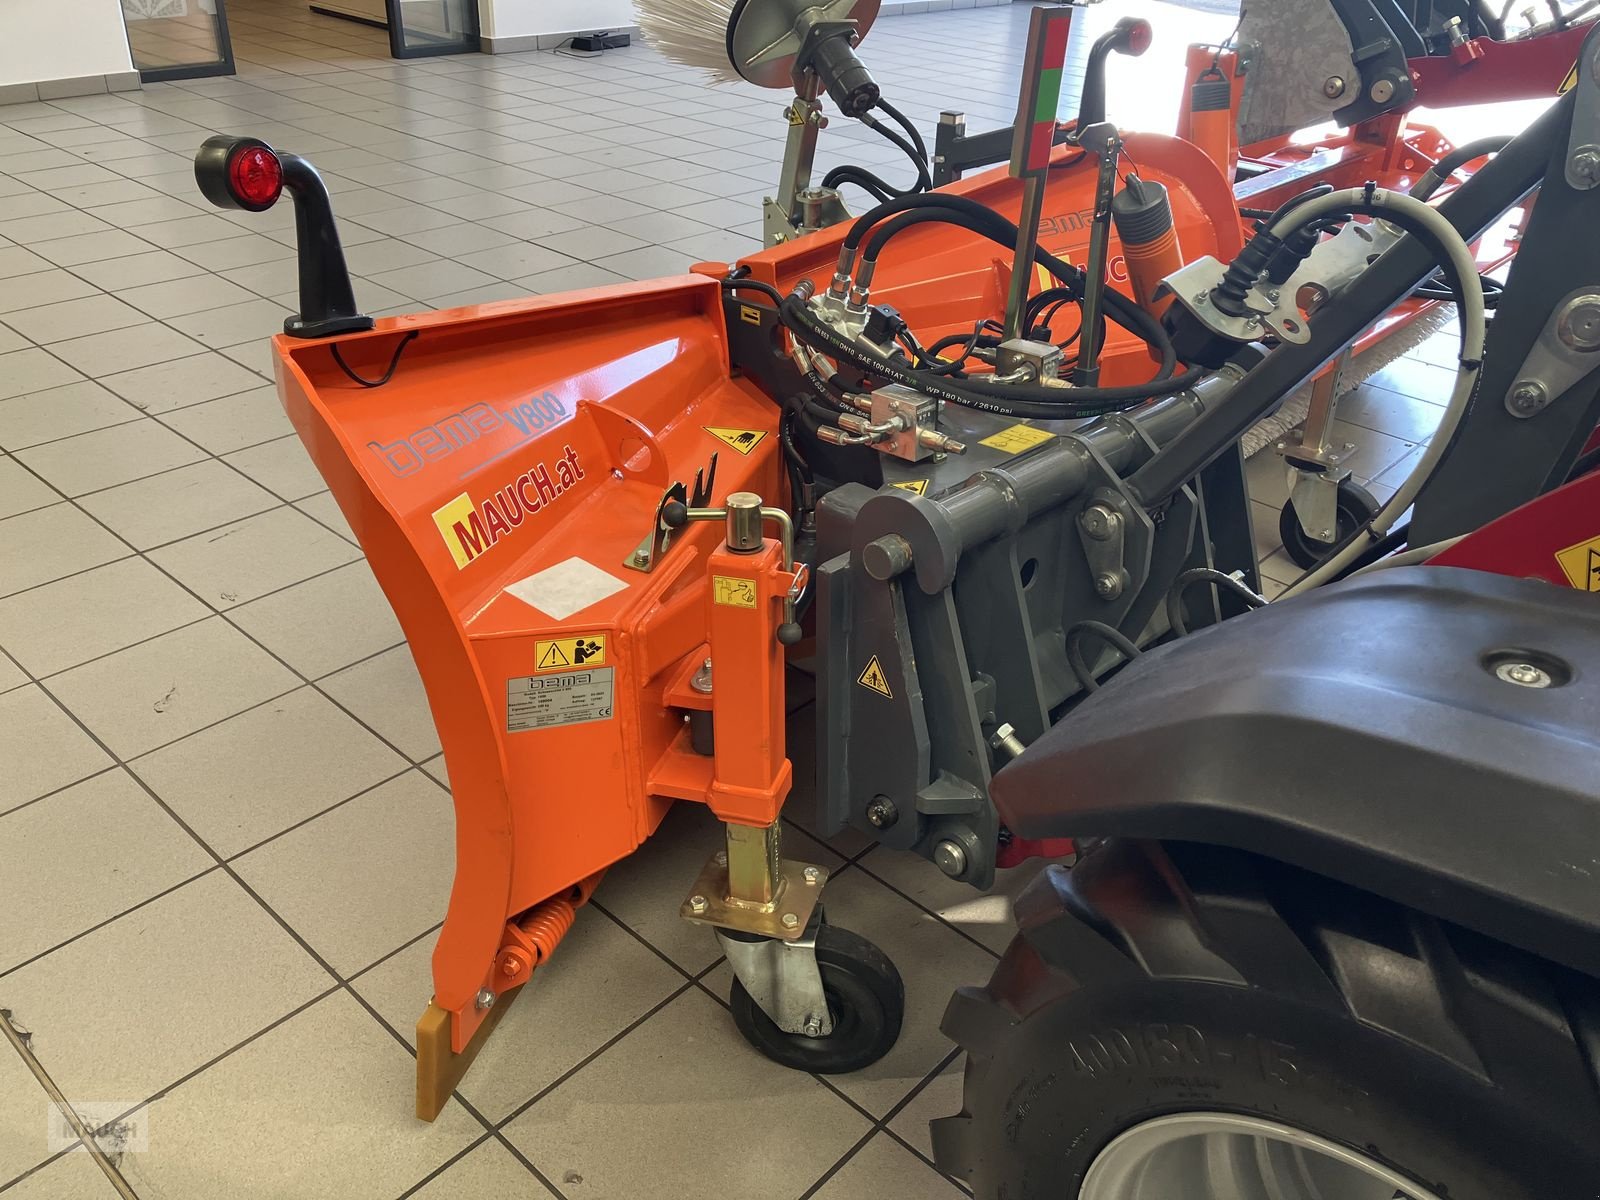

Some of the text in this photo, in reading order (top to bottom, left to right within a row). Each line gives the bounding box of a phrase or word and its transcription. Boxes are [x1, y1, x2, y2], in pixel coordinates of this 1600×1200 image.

[808, 372, 816, 382] EN
[813, 326, 821, 334] EN
[839, 342, 855, 356] DN10
[858, 353, 872, 366] SAE
[872, 361, 884, 372] 100
[884, 367, 905, 380] R1AT
[925, 385, 940, 394] WP
[942, 391, 956, 401] 180
[956, 396, 971, 405] bar
[978, 402, 999, 412] 2610
[1000, 407, 1013, 415] psi
[366, 390, 567, 479] bema V800
[451, 445, 584, 562] MAUCH.at
[528, 673, 592, 692] bema
